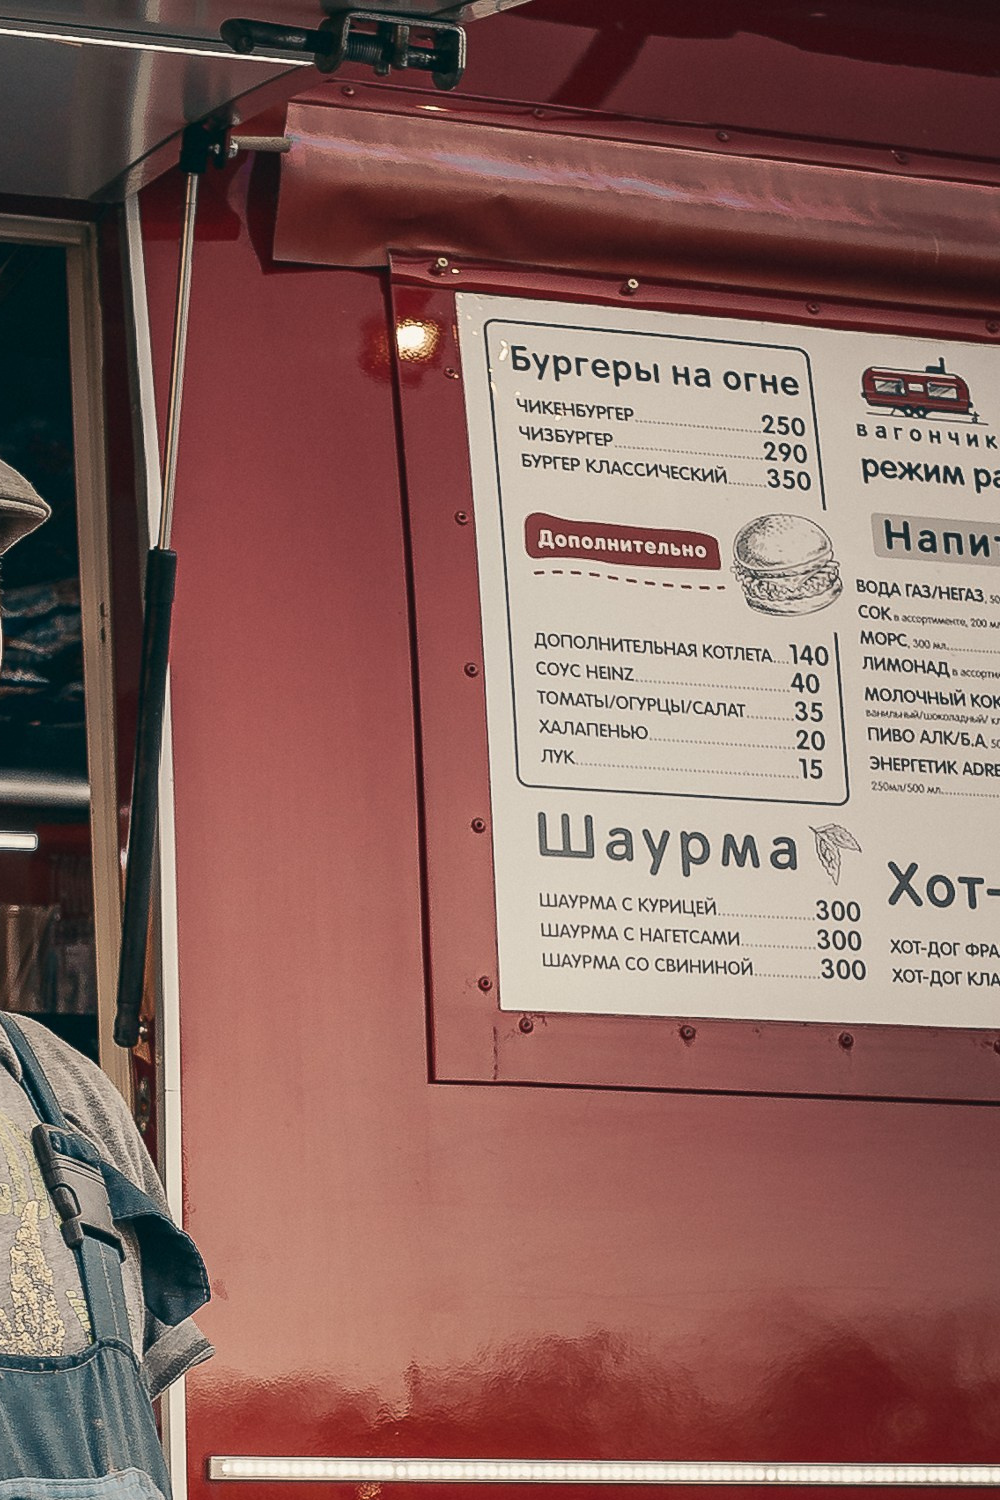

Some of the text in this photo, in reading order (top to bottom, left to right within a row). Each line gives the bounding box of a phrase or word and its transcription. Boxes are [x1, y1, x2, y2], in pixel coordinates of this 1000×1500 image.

[511, 345, 800, 397] Бургеры на огне
[516, 398, 805, 436] ЧИКЕНБУРГЕР 250
[519, 426, 807, 463] ЧИЗБУРГЕР 290
[856, 423, 998, 450] вагончик
[522, 453, 811, 491] БУРГЕР КЛАССИЧЕСКИЙ 350
[862, 457, 965, 485] режим
[538, 529, 706, 559] Дополнительно
[856, 579, 901, 598] ВОДА
[858, 605, 892, 621] СОК
[970, 619, 987, 628] 200
[535, 633, 828, 666] ДОПОЛНИТЕЛЬНАЯ КОТЛЕТА 140
[913, 640, 931, 650] 300
[536, 662, 820, 694] СОУС HEINZ 40
[862, 656, 950, 678] ЛИМОНАД
[537, 690, 824, 722] ТОМАТЫ/ОГУРЦЫ/САЛАТ 35
[864, 686, 966, 706] МОЛОЧНЫЙ
[539, 719, 825, 751] ХАЛАПЕНЬЮ 20
[867, 727, 915, 743] ПИВО
[541, 749, 823, 779] ЛУК 15
[869, 755, 958, 775] ЭНЕРГЕТИК
[538, 812, 798, 876] Шаурма
[540, 893, 861, 922] ШАУРМА С КУРИЦЕЙ 300
[541, 923, 862, 951] ШАУРМА С НАГЕТСАМИ 300
[890, 939, 960, 958] ХОТ-ДОГ
[542, 953, 866, 981] ШАУРМА СО СВИНИНОЙ 300
[892, 968, 962, 987] ХОТ-ДОГ
